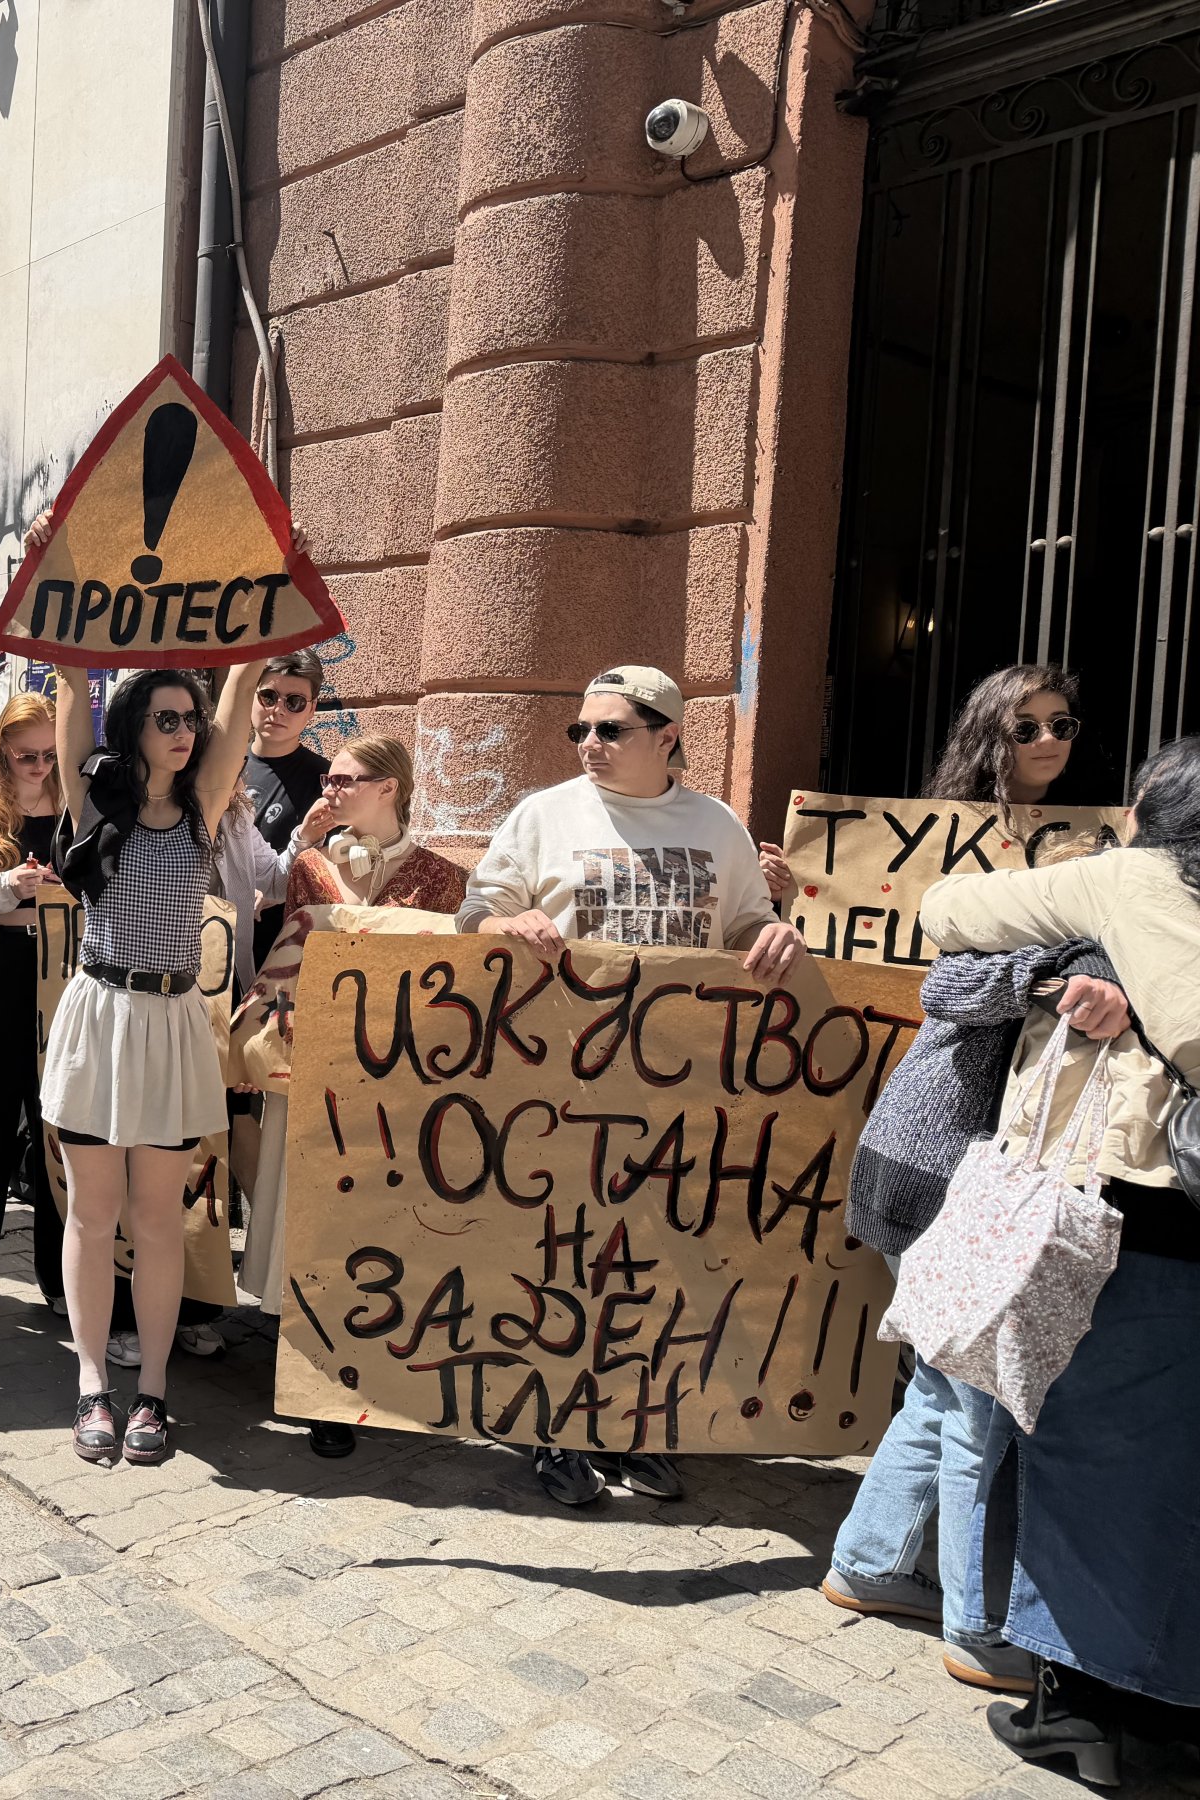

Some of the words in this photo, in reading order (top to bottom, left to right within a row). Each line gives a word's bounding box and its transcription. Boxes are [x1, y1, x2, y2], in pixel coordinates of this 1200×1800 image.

[30, 574, 292, 646] ПРОТЕСТ
[573, 847, 719, 909] TIME
[796, 809, 998, 875] ТУК
[574, 887, 608, 907] FOR
[332, 947, 922, 1117] ИЗКУСТВОТ
[418, 1091, 842, 1263] ОСТАНА
[535, 1203, 659, 1298] НА
[407, 1351, 693, 1452] ПЛАН
